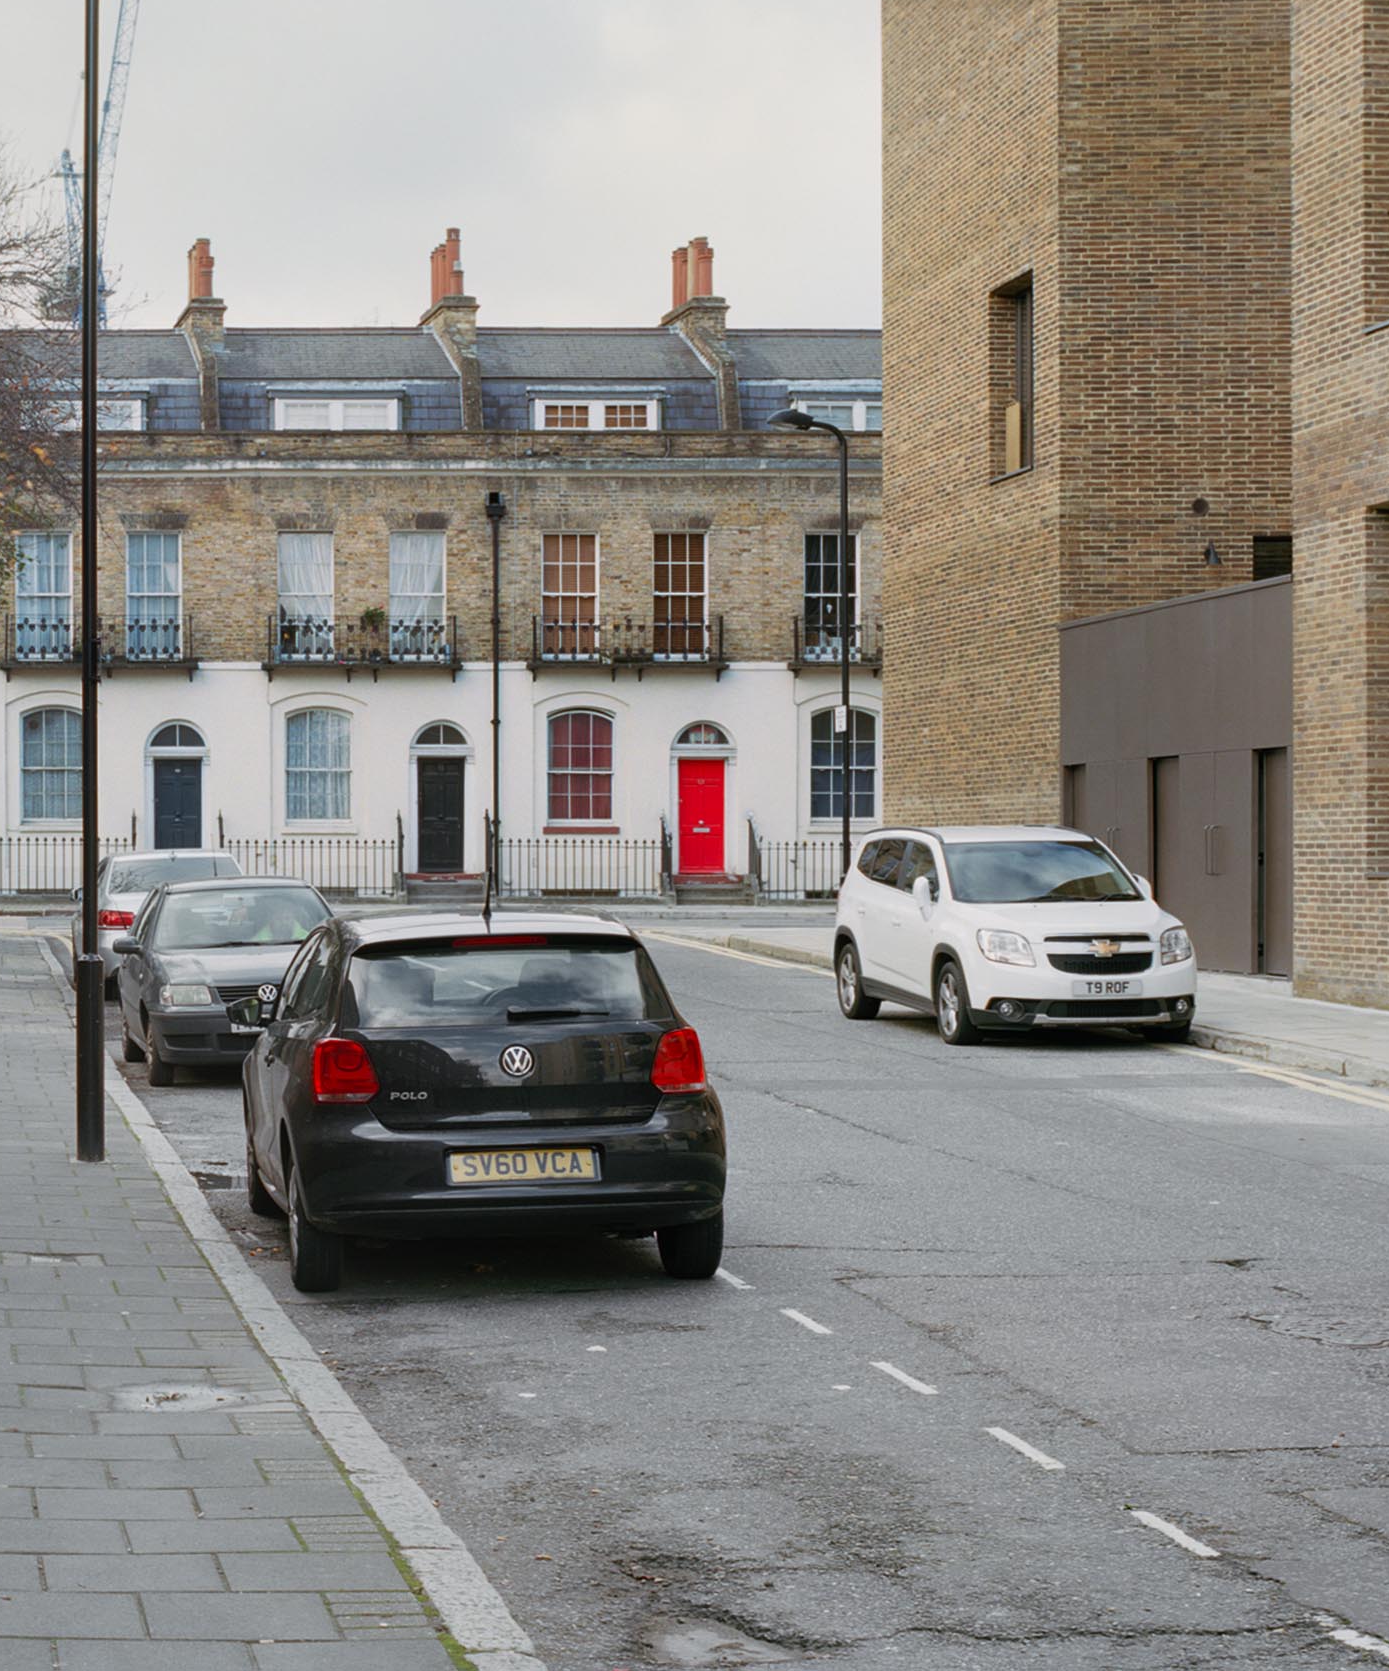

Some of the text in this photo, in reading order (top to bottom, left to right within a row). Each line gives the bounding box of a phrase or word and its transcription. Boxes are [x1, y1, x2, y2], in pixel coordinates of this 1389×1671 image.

[1086, 980, 1130, 994] T9 ROF
[502, 1045, 533, 1076] VW
[390, 1091, 428, 1101] POLO
[462, 1151, 583, 1177] SV60 VCA
